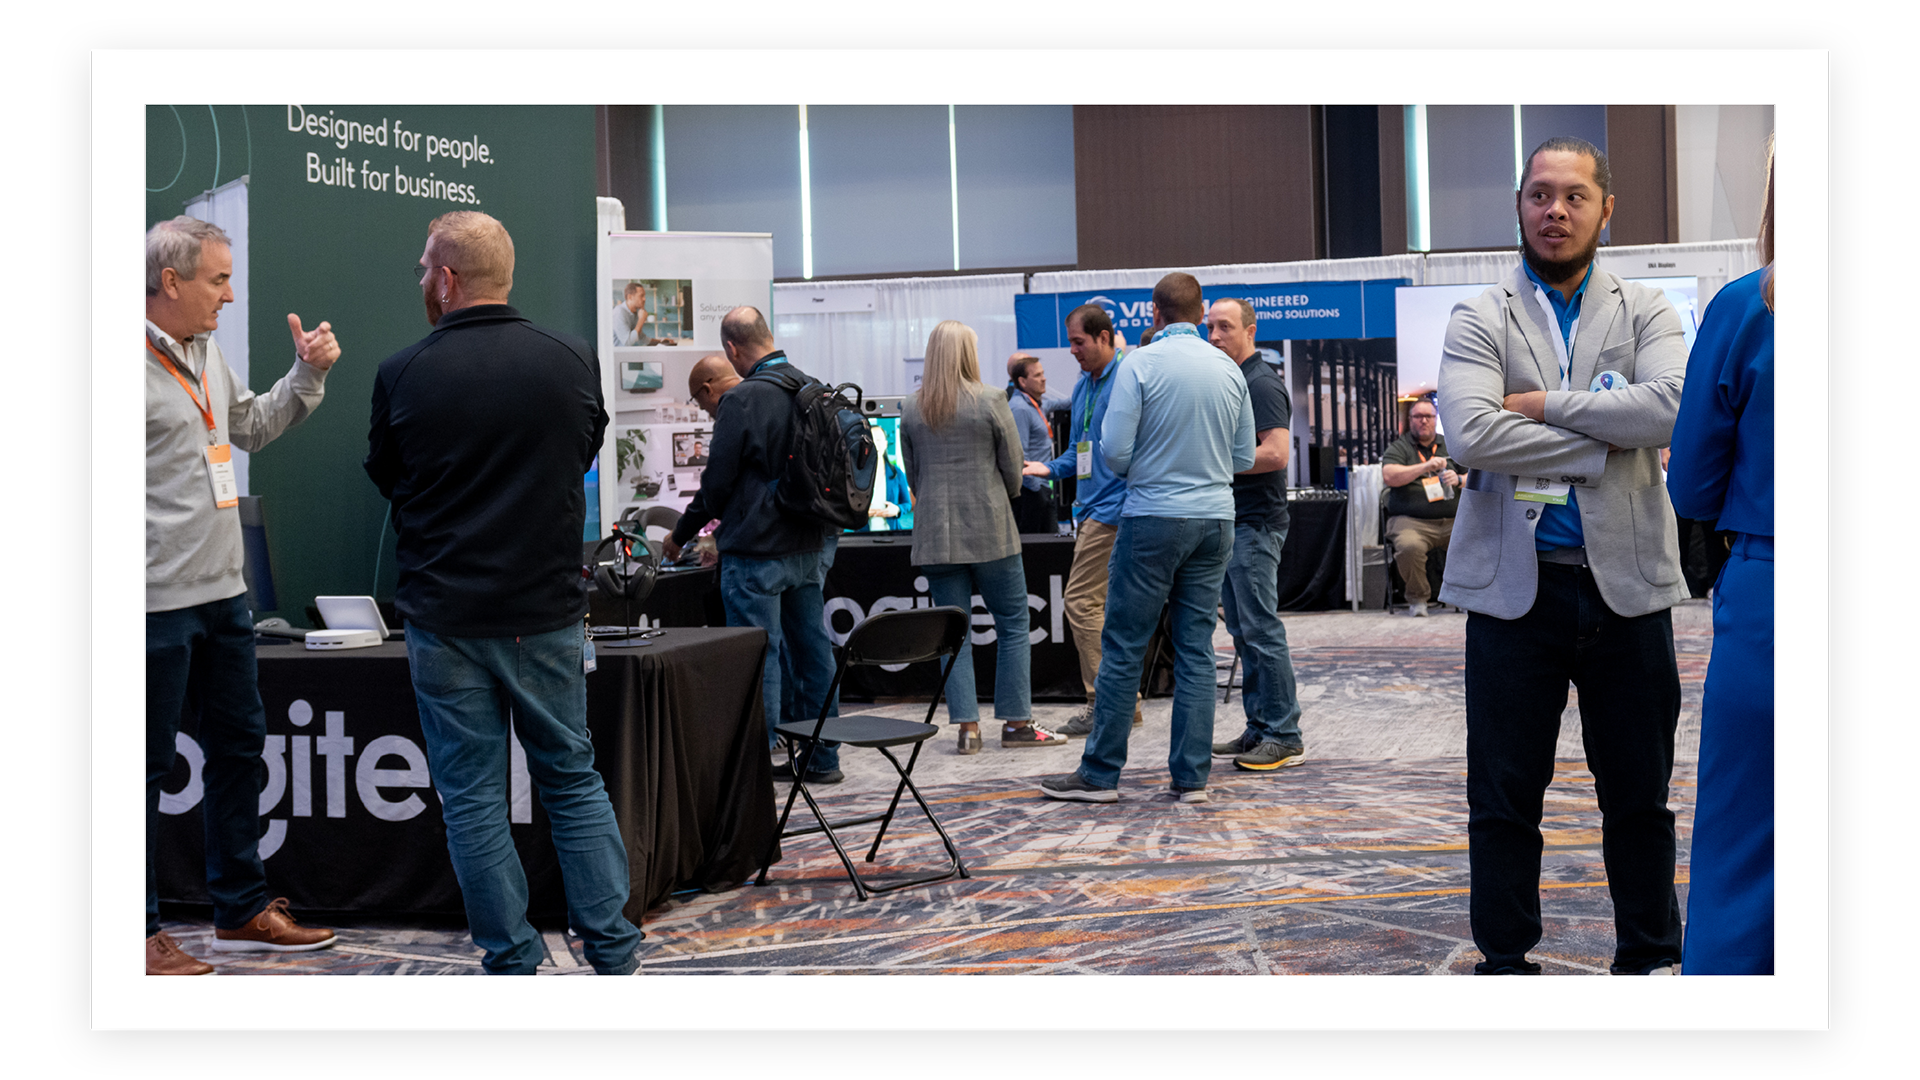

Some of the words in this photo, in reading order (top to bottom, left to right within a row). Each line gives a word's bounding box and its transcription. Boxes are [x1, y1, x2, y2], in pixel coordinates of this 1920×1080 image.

[287, 104, 388, 150] Designed
[393, 119, 422, 152] for
[426, 134, 495, 169] people.
[306, 151, 357, 189] Built
[360, 159, 391, 192] for
[395, 164, 481, 205] business.
[1240, 294, 1310, 308] GINEERED
[1284, 308, 1341, 320] SOLUTIONS
